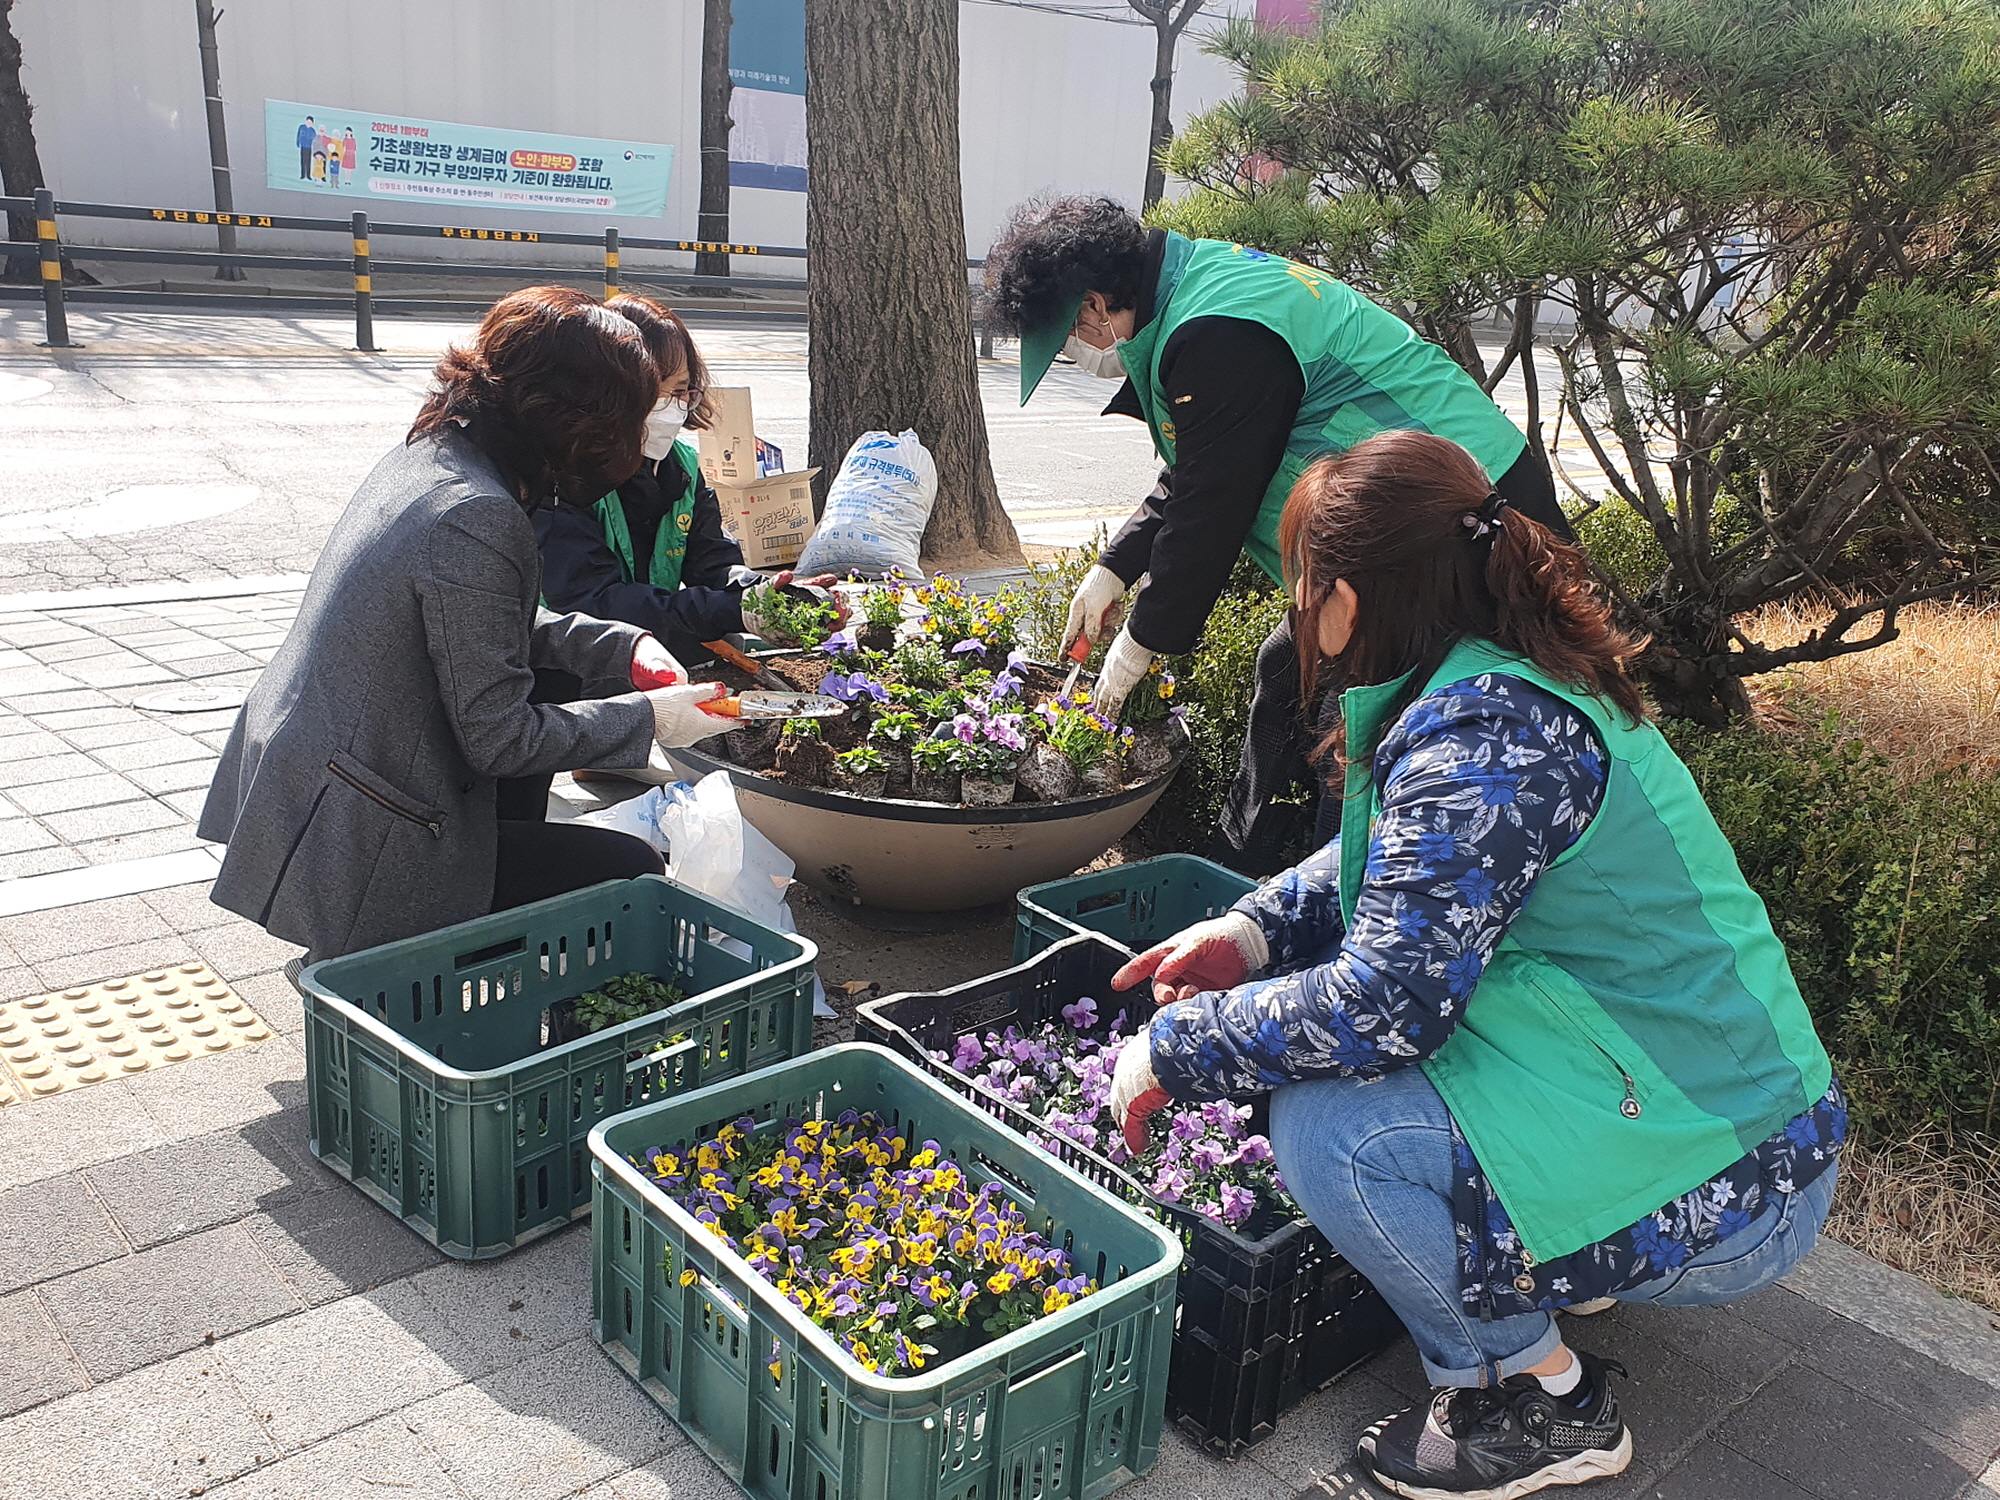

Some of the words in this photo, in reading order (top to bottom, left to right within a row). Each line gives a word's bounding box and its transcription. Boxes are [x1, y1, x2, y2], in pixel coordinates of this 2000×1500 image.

[371, 122, 398, 134] 2021년
[400, 126, 429, 138] 1월부터
[370, 137, 453, 160] 기초생활보장
[456, 146, 507, 165] 생계급여
[514, 151, 574, 170] 노인·한부모
[578, 157, 604, 173] 포함
[369, 156, 411, 175] 수급자
[414, 161, 441, 177] 가구
[443, 163, 508, 183] 부양의무자
[511, 170, 549, 187] 기준이
[551, 173, 614, 191] 완화됩니다.
[152, 209, 273, 227] 무단횡단금지
[442, 227, 539, 242] 무단횡단금지
[678, 241, 758, 255] 무단횡단금지
[752, 502, 802, 536] 유한락스
